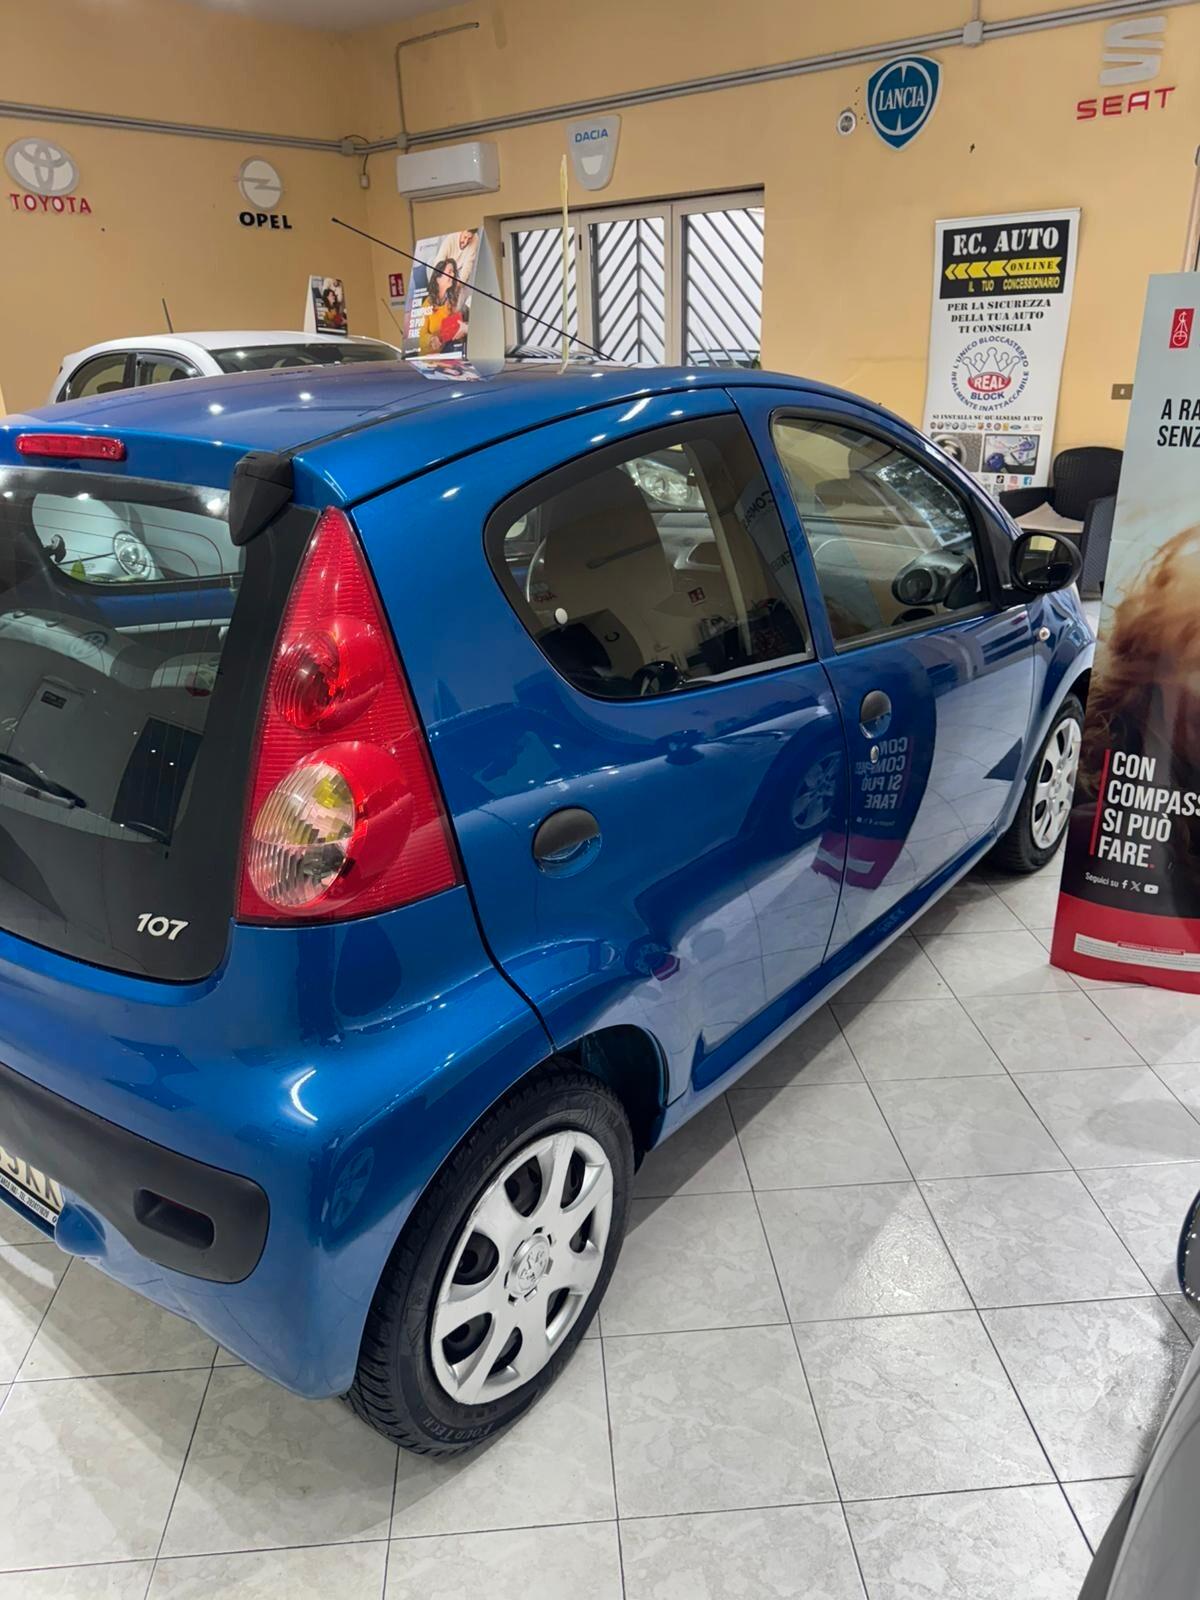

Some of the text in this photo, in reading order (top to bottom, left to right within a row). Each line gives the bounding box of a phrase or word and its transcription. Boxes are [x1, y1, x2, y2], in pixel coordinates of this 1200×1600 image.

[877, 85, 925, 112] LANCIA
[1076, 86, 1176, 121] SEAT
[574, 128, 609, 143] DACIA
[10, 193, 92, 215] TOYOTA
[239, 211, 292, 230] OPEL
[953, 227, 1059, 255] F.C. AUTO
[1010, 261, 1054, 271] ONLINE
[968, 277, 1060, 292] IL TUO CONCESSIONARIO
[947, 298, 1052, 312] PER LA SICUREZZA
[951, 310, 1045, 323] DELLA TUA AUTO
[958, 322, 1032, 334] TI CONSIGLIA
[979, 336, 1029, 367] BLOCCASTERZO
[974, 374, 1006, 390] REAL
[971, 392, 1005, 401] BLOCK
[1160, 398, 1172, 420] A
[1112, 751, 1156, 782] CON
[1102, 808, 1172, 842] SI PUÒ
[1098, 835, 1155, 868] FARE.
[1085, 871, 1119, 888] Seguici su
[136, 912, 190, 941] 107
